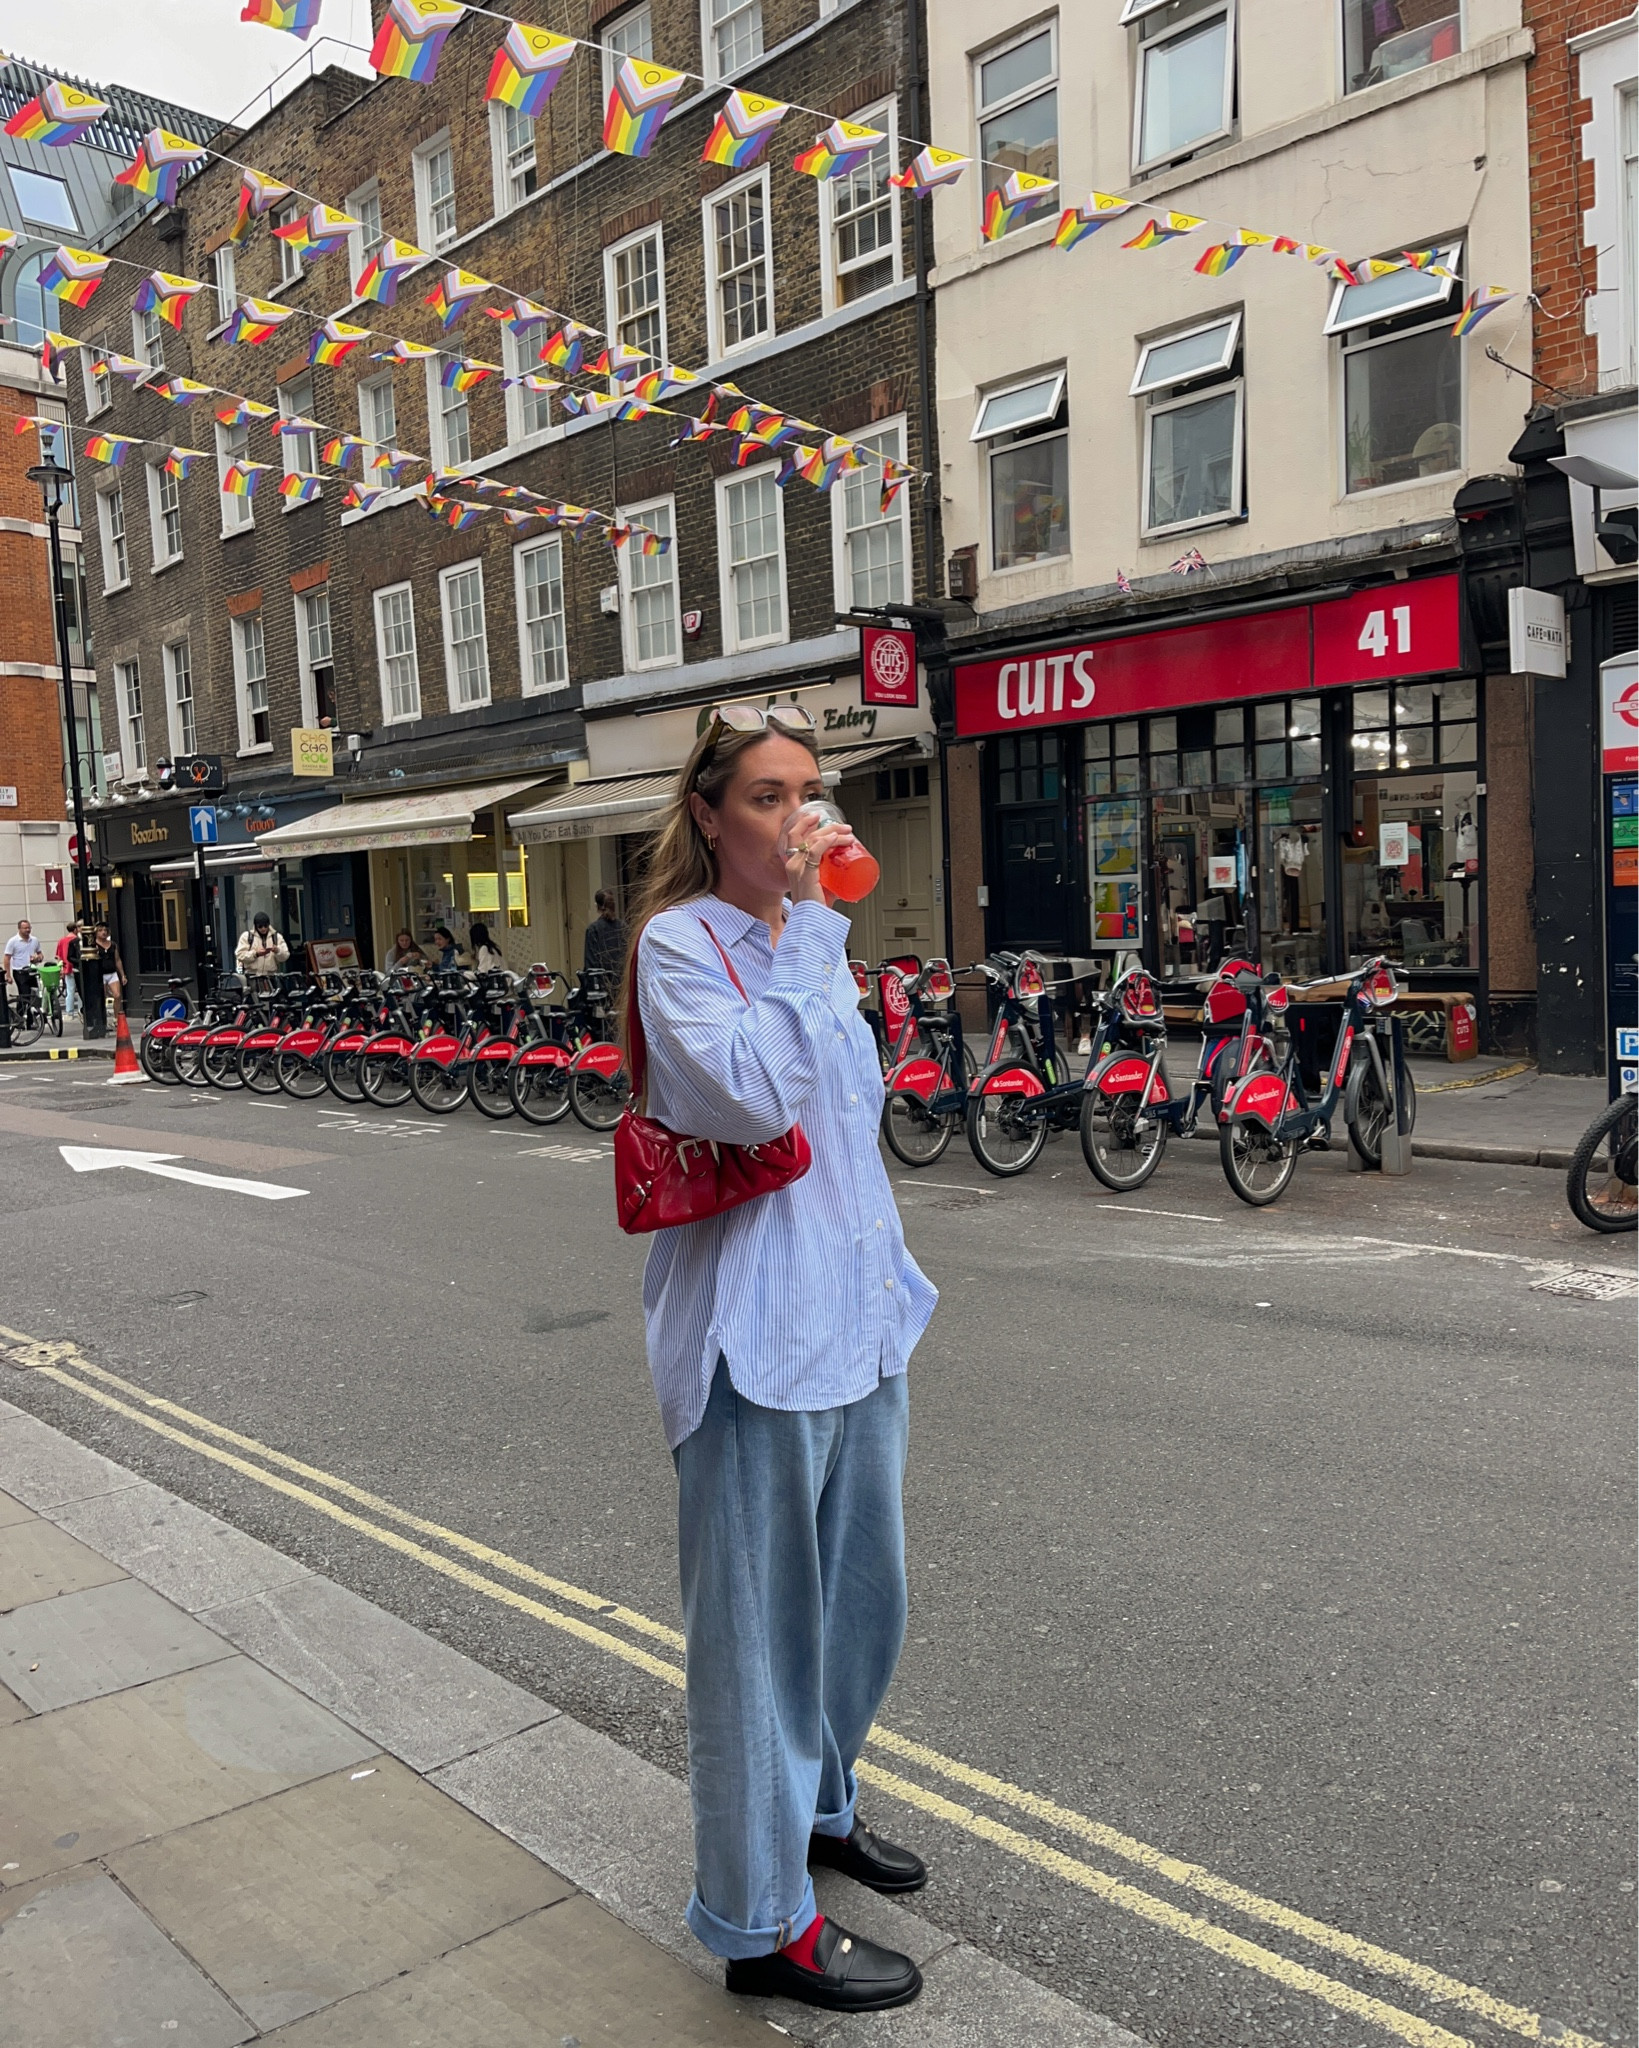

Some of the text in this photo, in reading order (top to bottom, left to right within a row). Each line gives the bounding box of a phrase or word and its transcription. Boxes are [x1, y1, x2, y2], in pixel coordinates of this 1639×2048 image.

[1358, 605, 1411, 657] 41
[1526, 625, 1543, 640] CAFE
[1547, 630, 1563, 644] NATA
[880, 652, 901, 668] CUTS
[997, 650, 1095, 719] CUTS
[823, 705, 877, 738] Eatery
[300, 733, 327, 743] CHA
[300, 743, 328, 753] CHA
[528, 830, 541, 841] You
[543, 828, 557, 840] Can
[558, 826, 572, 837] Eat
[572, 823, 594, 836] Sushi
[1024, 846, 1036, 860] 41
[432, 1044, 456, 1053] Santander
[593, 1053, 619, 1063] Santander
[910, 1069, 935, 1081] Santander
[1115, 1071, 1143, 1083] Santander
[999, 1079, 1024, 1087] Santander
[1253, 1087, 1280, 1101] Santander
[317, 1119, 615, 1163] CYCLE HIRE
